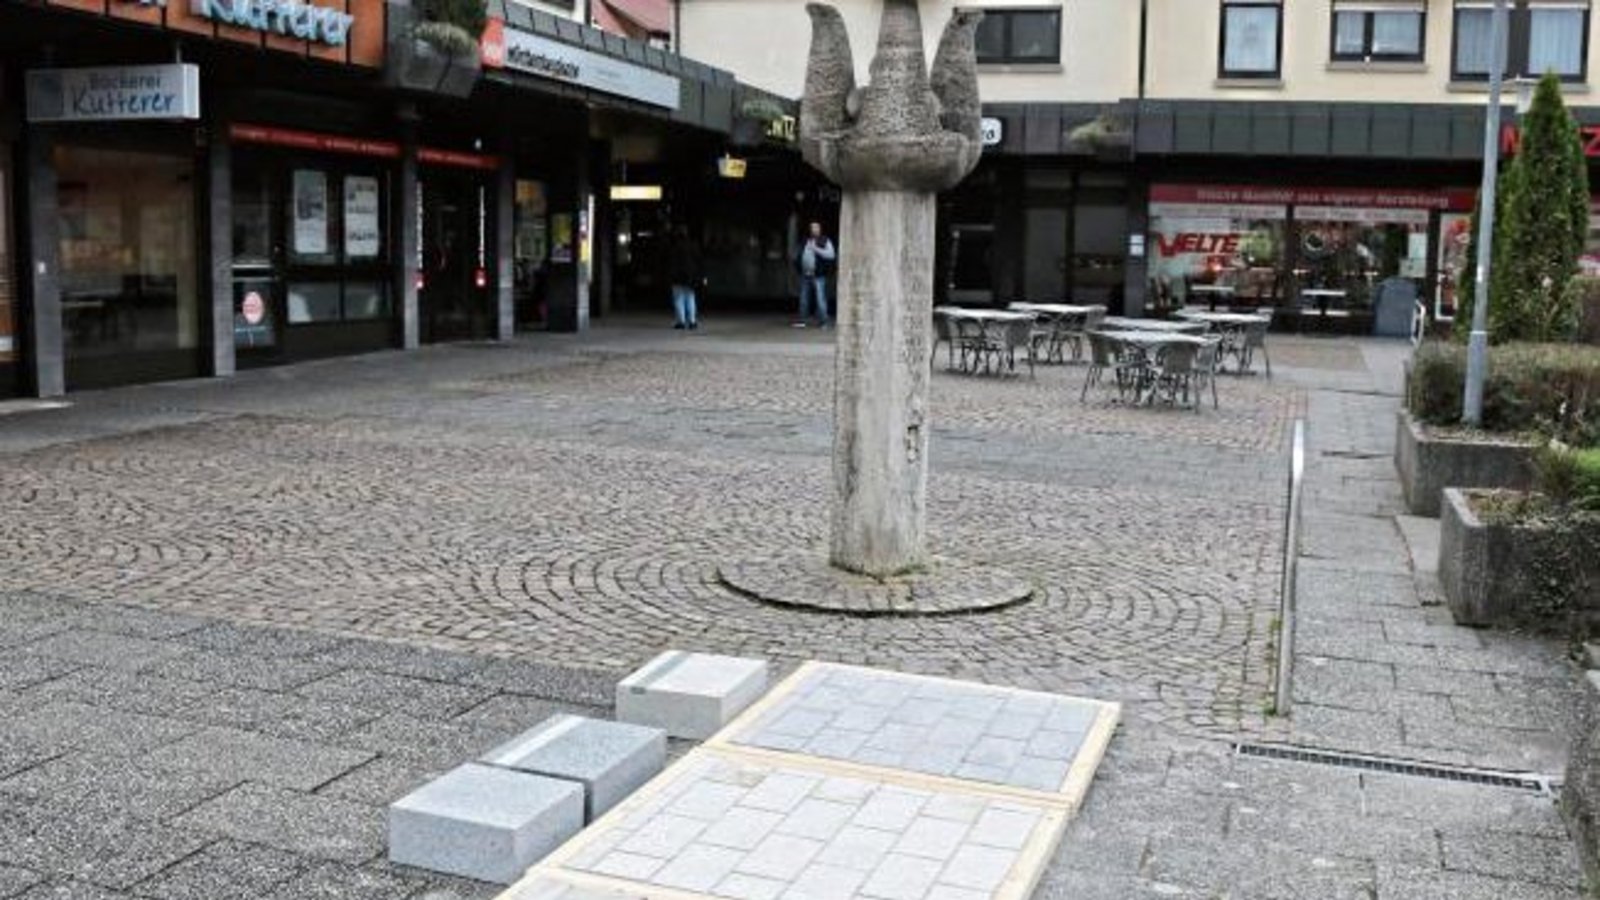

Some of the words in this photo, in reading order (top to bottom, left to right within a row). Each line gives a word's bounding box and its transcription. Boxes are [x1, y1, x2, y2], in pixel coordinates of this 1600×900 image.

[200, 0, 354, 46] Kutterer
[73, 87, 175, 114] Kutterer
[1156, 232, 1238, 257] VELTE
